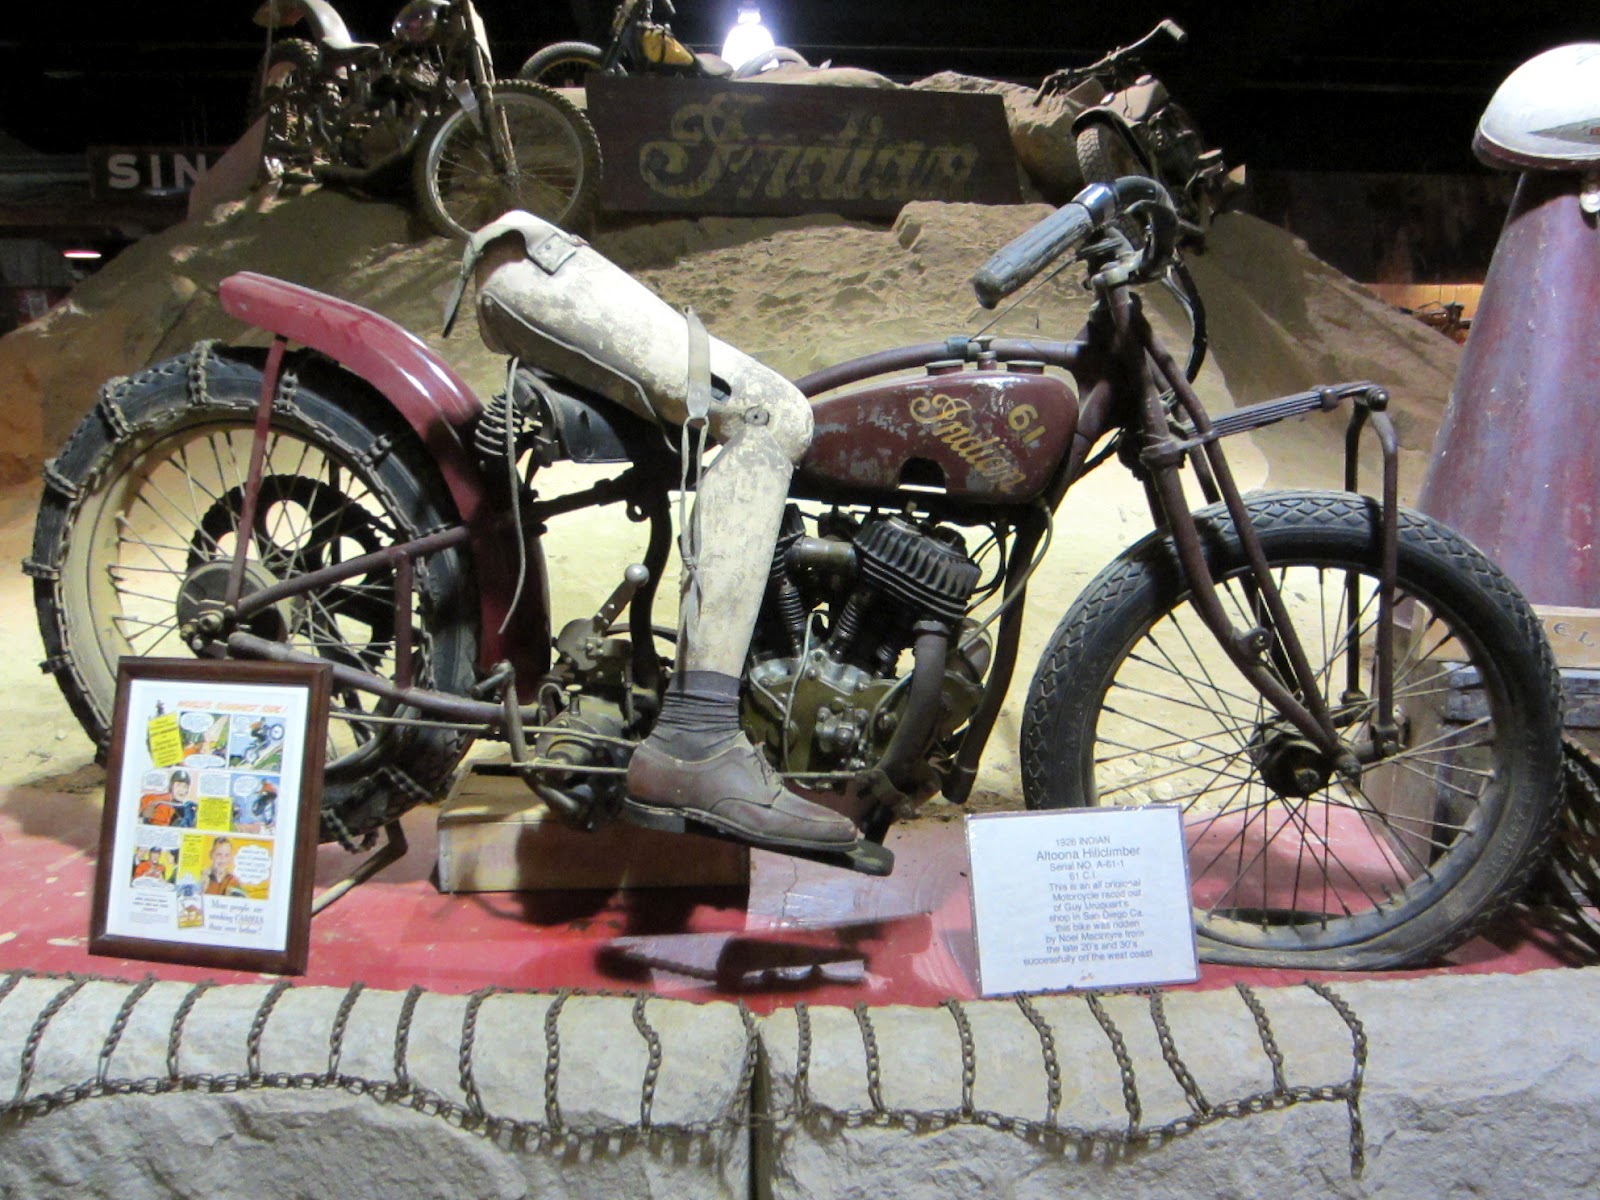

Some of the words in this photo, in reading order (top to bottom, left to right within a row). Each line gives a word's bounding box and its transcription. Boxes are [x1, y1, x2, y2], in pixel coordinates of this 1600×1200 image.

[639, 91, 978, 199] Indian
[1008, 404, 1046, 444] 61
[910, 393, 1026, 493] Indian
[1079, 836, 1110, 846] INDIAN
[1036, 850, 1079, 861] Altoona
[1082, 846, 1140, 859] Hillclimber
[1050, 862, 1074, 872] Serial
[1050, 882, 1068, 892] This
[1070, 882, 1077, 891] is
[1080, 882, 1090, 890] an
[1093, 880, 1102, 890] all
[1052, 892, 1099, 902] Motorcycle
[1102, 890, 1126, 898] raced
[1128, 888, 1142, 897] out
[1054, 902, 1062, 912] of
[1064, 902, 1082, 912] Guy
[1049, 914, 1070, 923] shop
[1072, 912, 1080, 920] in
[1083, 912, 1100, 920] San
[1102, 910, 1128, 920] Diego
[1056, 924, 1070, 932] this
[1072, 922, 1091, 931] bike
[1094, 922, 1111, 930] was
[1113, 919, 1140, 929] ridden
[1046, 935, 1056, 944] by
[1058, 932, 1078, 942] Noel
[1125, 929, 1144, 938] from
[1046, 945, 1060, 954] the
[1062, 944, 1078, 953] late
[1102, 941, 1118, 950] and
[1092, 952, 1105, 961] the
[1107, 950, 1128, 960] west
[1129, 949, 1152, 959] coast
